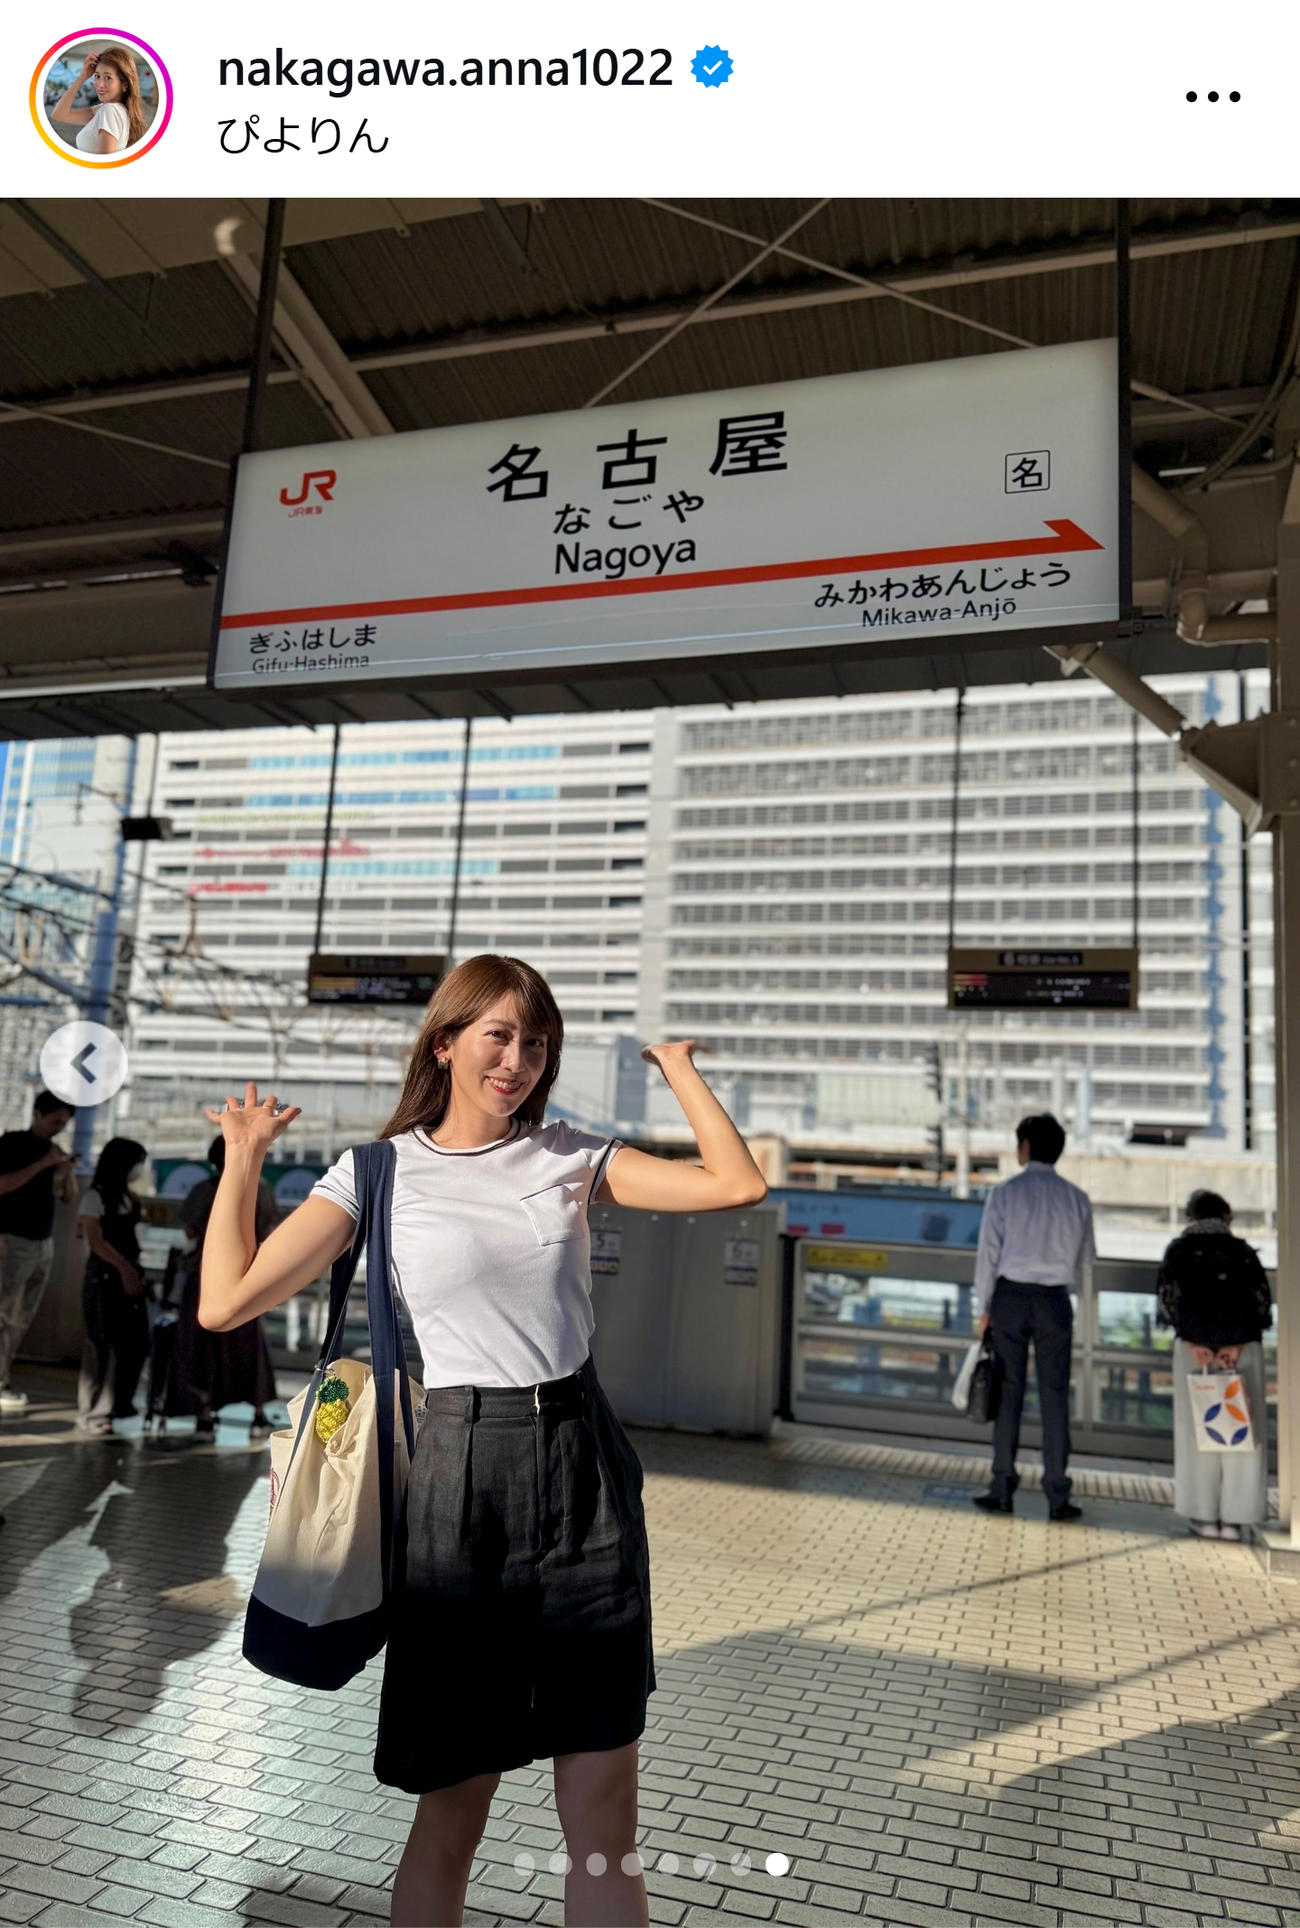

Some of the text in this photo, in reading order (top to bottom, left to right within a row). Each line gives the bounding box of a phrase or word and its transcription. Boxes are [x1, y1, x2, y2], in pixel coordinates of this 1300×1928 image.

[486, 411, 788, 502] 名古屋
[1012, 458, 1044, 489] 名
[280, 470, 337, 506] JR
[553, 490, 705, 535] なごや
[555, 536, 697, 580] Nagoya
[814, 561, 1071, 608] みかわあんじょう
[862, 597, 1017, 627] Mikawa-Anjō
[249, 624, 377, 654] ぎふはしま
[252, 653, 370, 675] Gifu-Hashima
